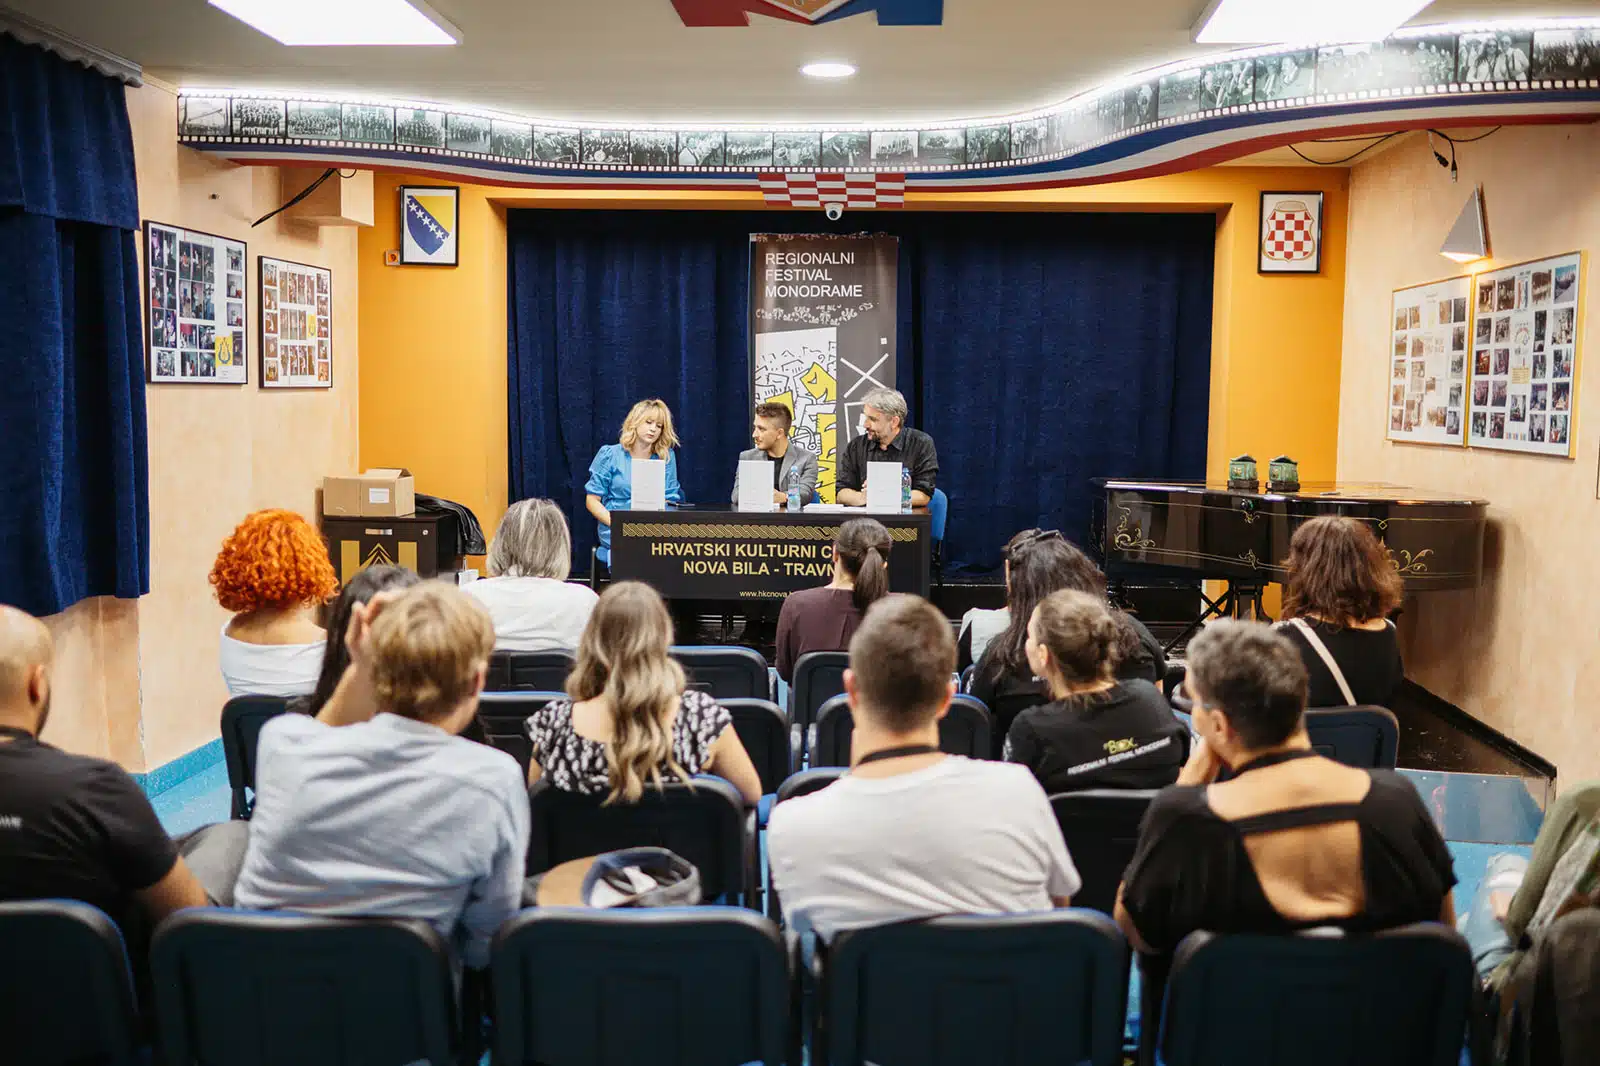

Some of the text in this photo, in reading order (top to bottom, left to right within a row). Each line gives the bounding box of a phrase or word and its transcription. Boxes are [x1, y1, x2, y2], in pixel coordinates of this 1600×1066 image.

[765, 252, 855, 265] REGIONALNI
[765, 268, 833, 281] FESTIVAL
[765, 285, 863, 298] MONODRAME
[651, 542, 834, 559] HRVATSKI KULTURNI C
[683, 560, 729, 575] NOVA
[732, 561, 770, 576] BILA
[783, 562, 836, 577] TRAVN
